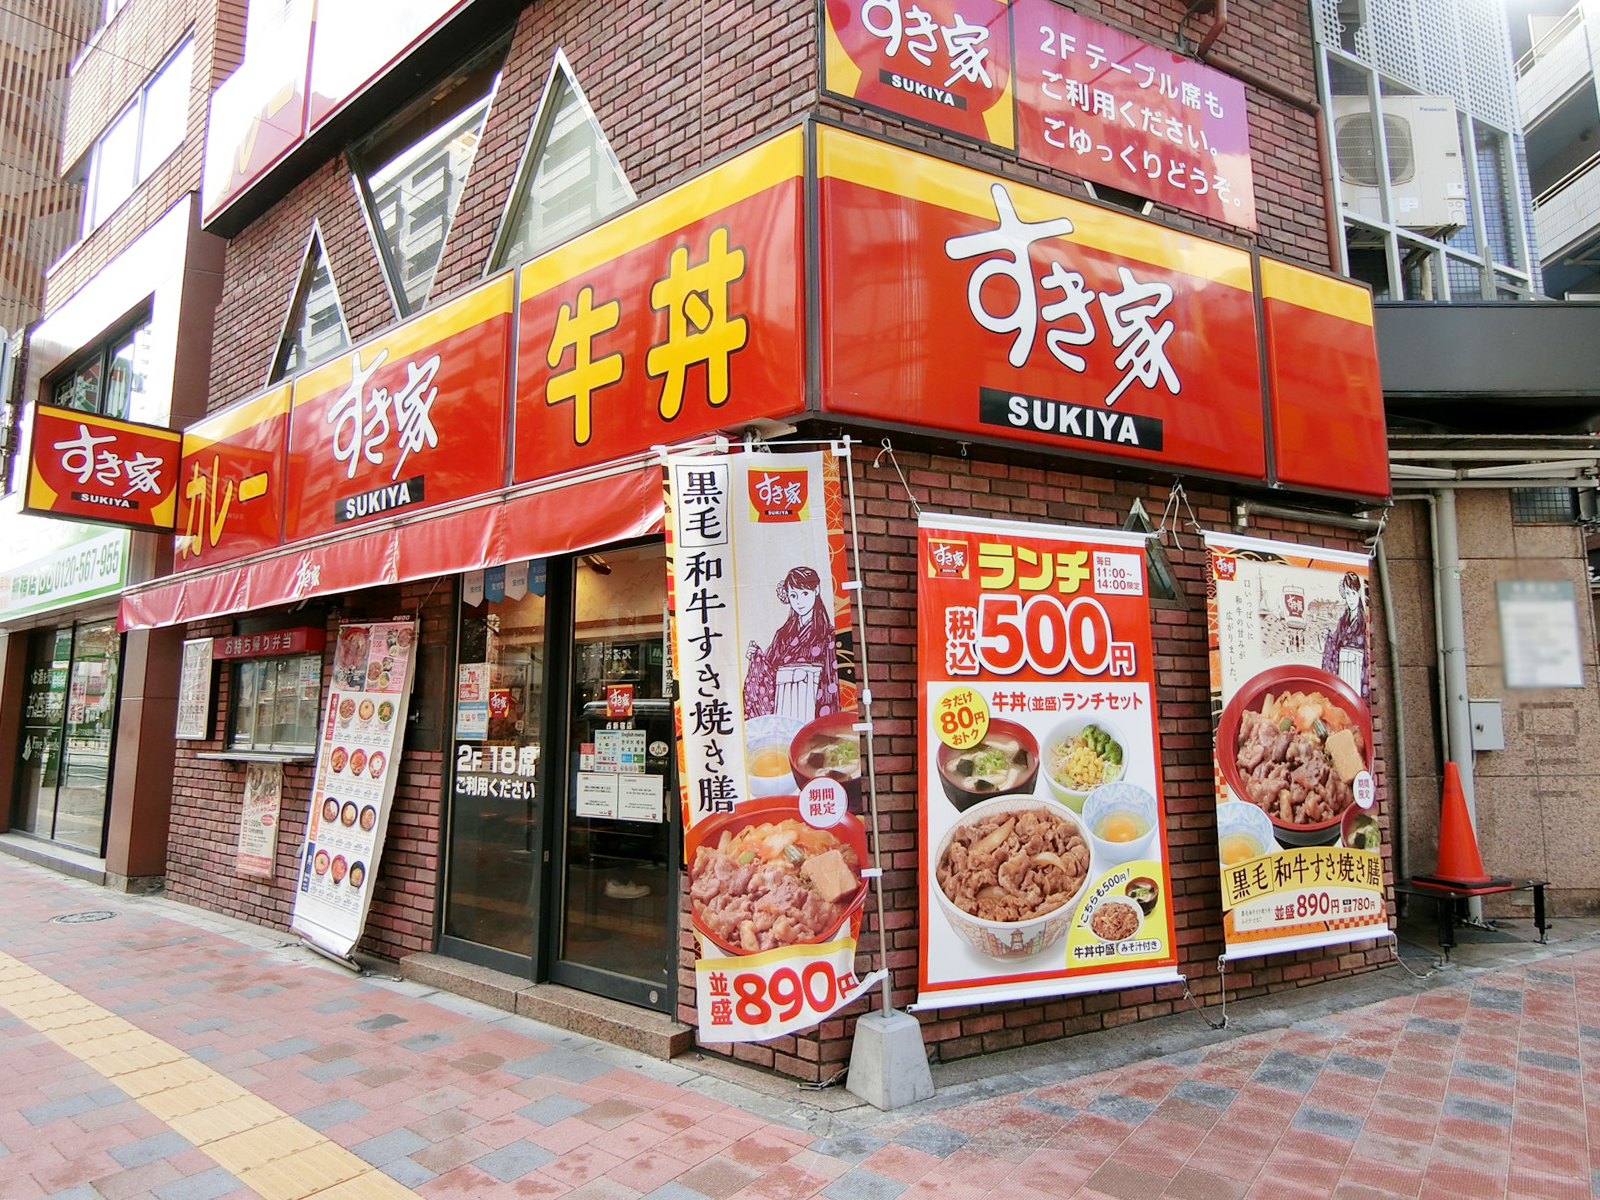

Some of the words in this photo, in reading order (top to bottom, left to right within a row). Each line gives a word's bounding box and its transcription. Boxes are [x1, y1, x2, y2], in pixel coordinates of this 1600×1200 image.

[861, 0, 993, 89] すき家
[891, 74, 955, 106] SUKIYA
[1039, 25, 1077, 59] 2F
[1084, 44, 1224, 119] テーブル席も
[1040, 69, 1218, 156] ご利用ください。
[1043, 116, 1241, 207] ごゆっくりどうぞ。
[944, 182, 1182, 406] すき家
[546, 225, 748, 445] 牛丼
[327, 348, 441, 480] すき家
[1008, 396, 1140, 446] SUKIYA
[54, 424, 163, 498] すき家
[81, 493, 130, 508] SUKIYA
[183, 455, 268, 560] カレー
[346, 482, 411, 520] SUKIYA
[755, 473, 802, 509] すき家
[54, 540, 120, 590] 0120-567-955
[934, 543, 965, 569] すき家
[978, 542, 1091, 593] ランチ
[1096, 556, 1111, 566] 毎日
[225, 632, 292, 655] お持ち帰り弁当
[947, 609, 977, 673] 税込
[979, 598, 1135, 674] 500円
[940, 706, 986, 735] 80円
[941, 692, 973, 709] 今だけ
[457, 744, 483, 772] 2F
[490, 745, 541, 777] 18席
[952, 728, 979, 746] おトク
[456, 776, 537, 800] ご利用ください
[809, 787, 835, 801] 期間
[809, 802, 836, 816] 限定
[1081, 872, 1127, 923] こちらも500円
[1074, 943, 1115, 958] 牛丼中盛
[1121, 941, 1157, 952] みそ汁付き
[709, 971, 733, 1025] 並盛
[733, 960, 860, 1026] 890円
